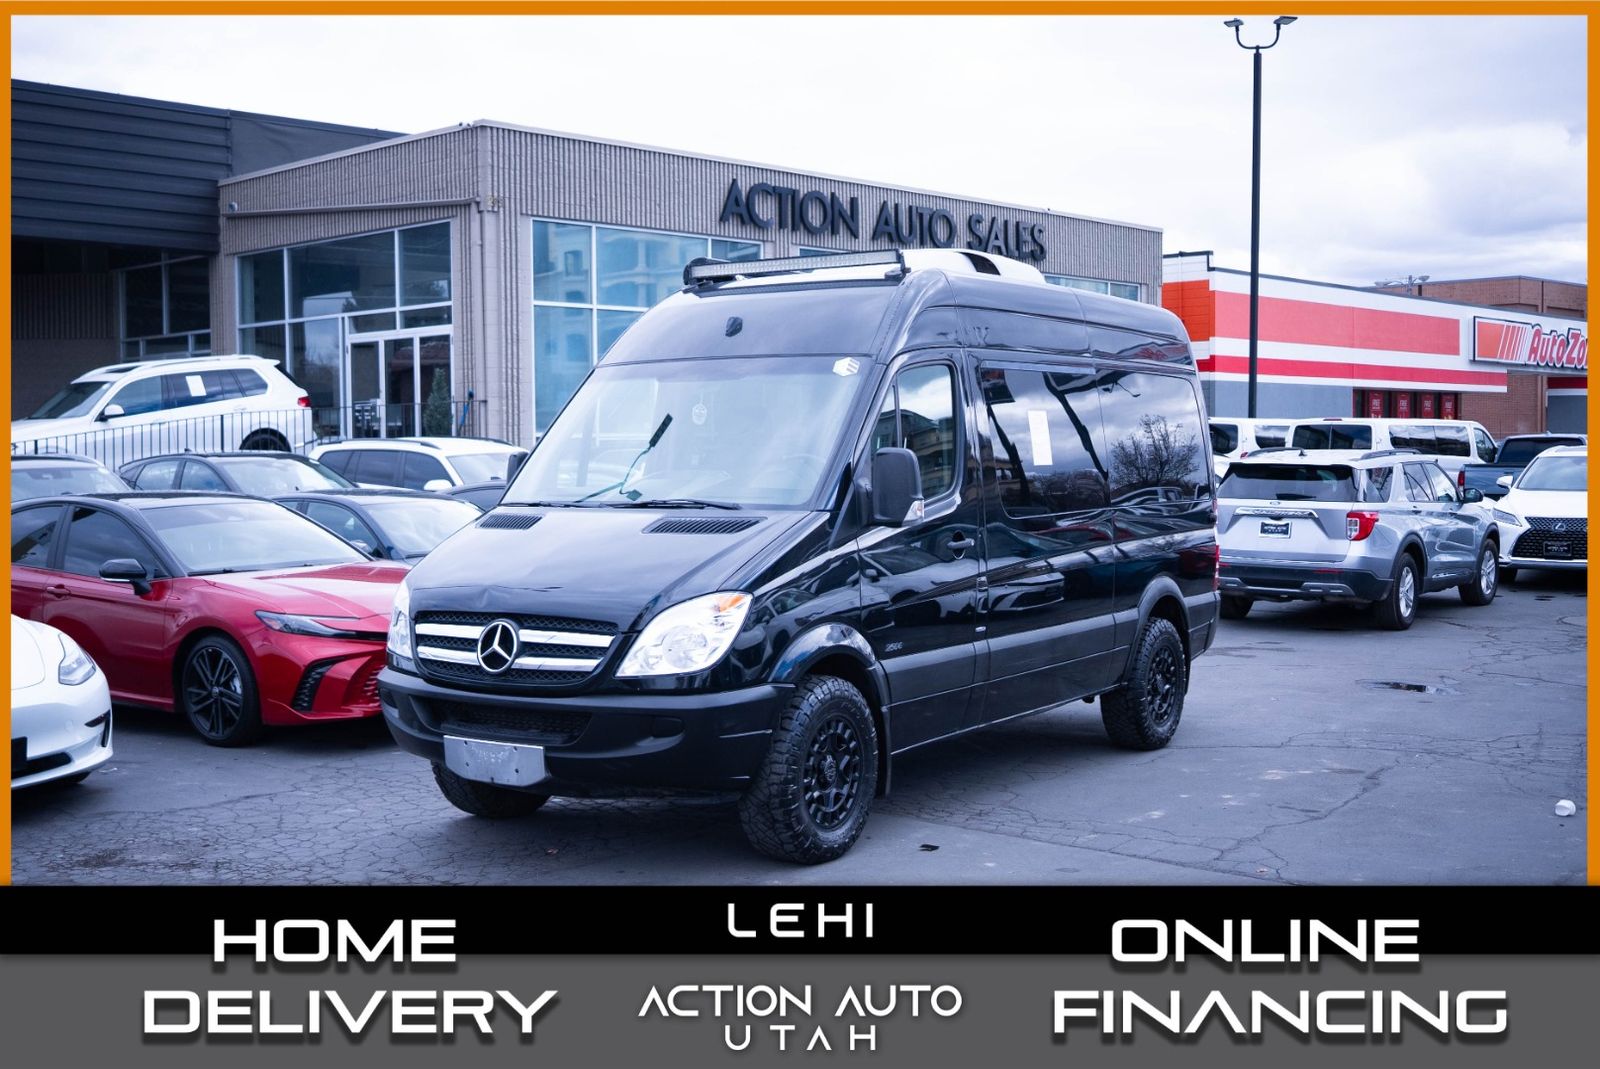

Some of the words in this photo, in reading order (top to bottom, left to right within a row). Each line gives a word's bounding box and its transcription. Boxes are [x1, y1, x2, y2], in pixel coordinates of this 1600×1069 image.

[720, 178, 858, 240] ACTION
[872, 200, 957, 248] AUTO
[967, 213, 1047, 261] SALES
[1527, 327, 1587, 367] AutoZo
